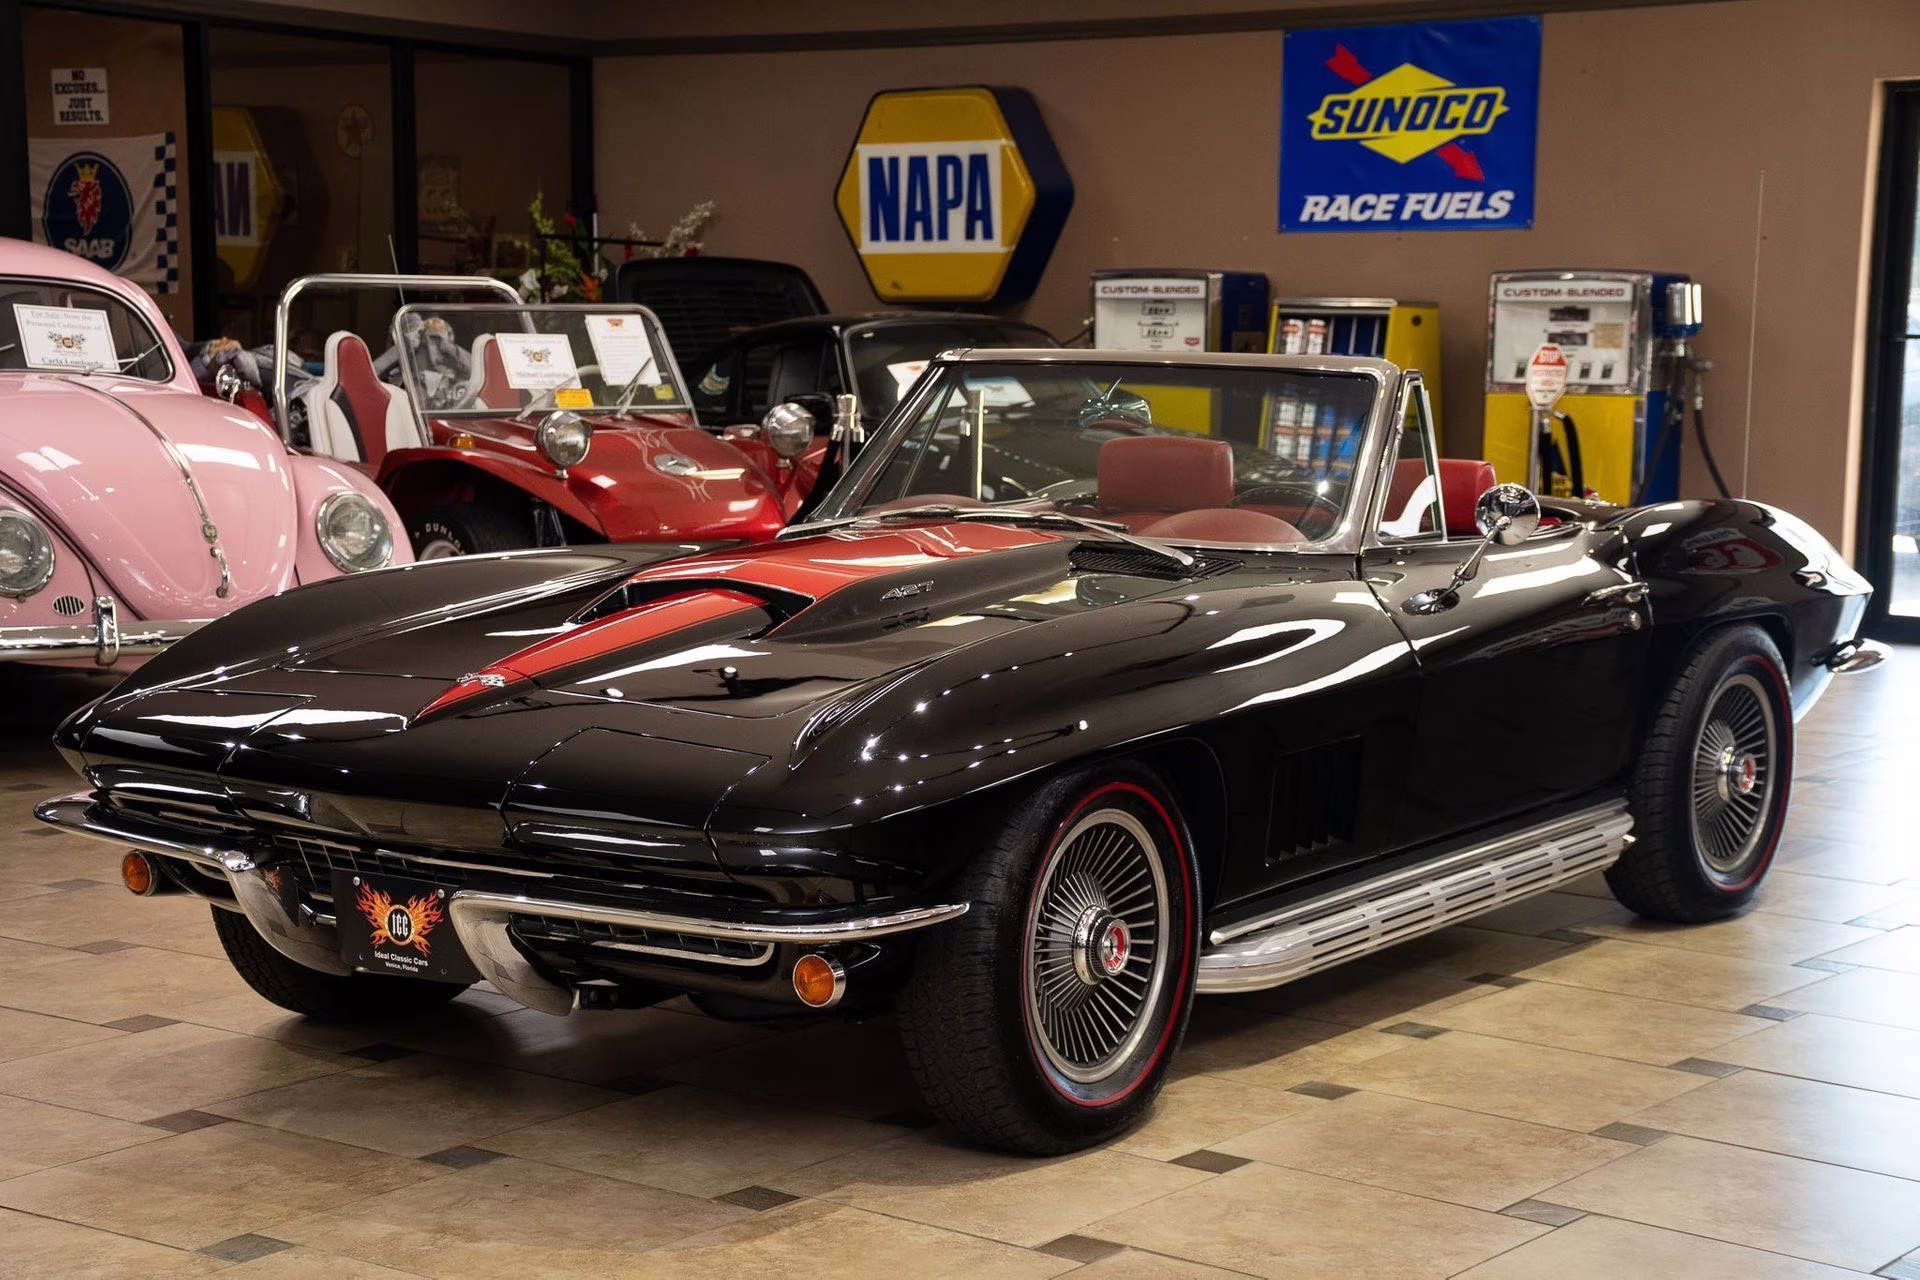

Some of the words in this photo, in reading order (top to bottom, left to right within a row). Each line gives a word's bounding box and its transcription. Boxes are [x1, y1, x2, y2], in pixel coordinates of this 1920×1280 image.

[72, 70, 85, 81] NO
[68, 97, 92, 109] JUST
[1318, 93, 1498, 134] SUNOCO
[59, 110, 104, 122] RESULTS.
[868, 152, 994, 242] NAPA
[1299, 193, 1400, 223] RACE
[1400, 190, 1515, 221] FUELS
[64, 237, 114, 259] SAAB
[425, 522, 464, 553] DUNLO
[879, 580, 934, 600] 427
[391, 913, 409, 937] ICC
[374, 950, 390, 960] Ideal
[390, 953, 413, 964] Classic
[413, 957, 428, 967] Cars
[385, 961, 403, 970] Venice,
[402, 964, 419, 973] Florida
